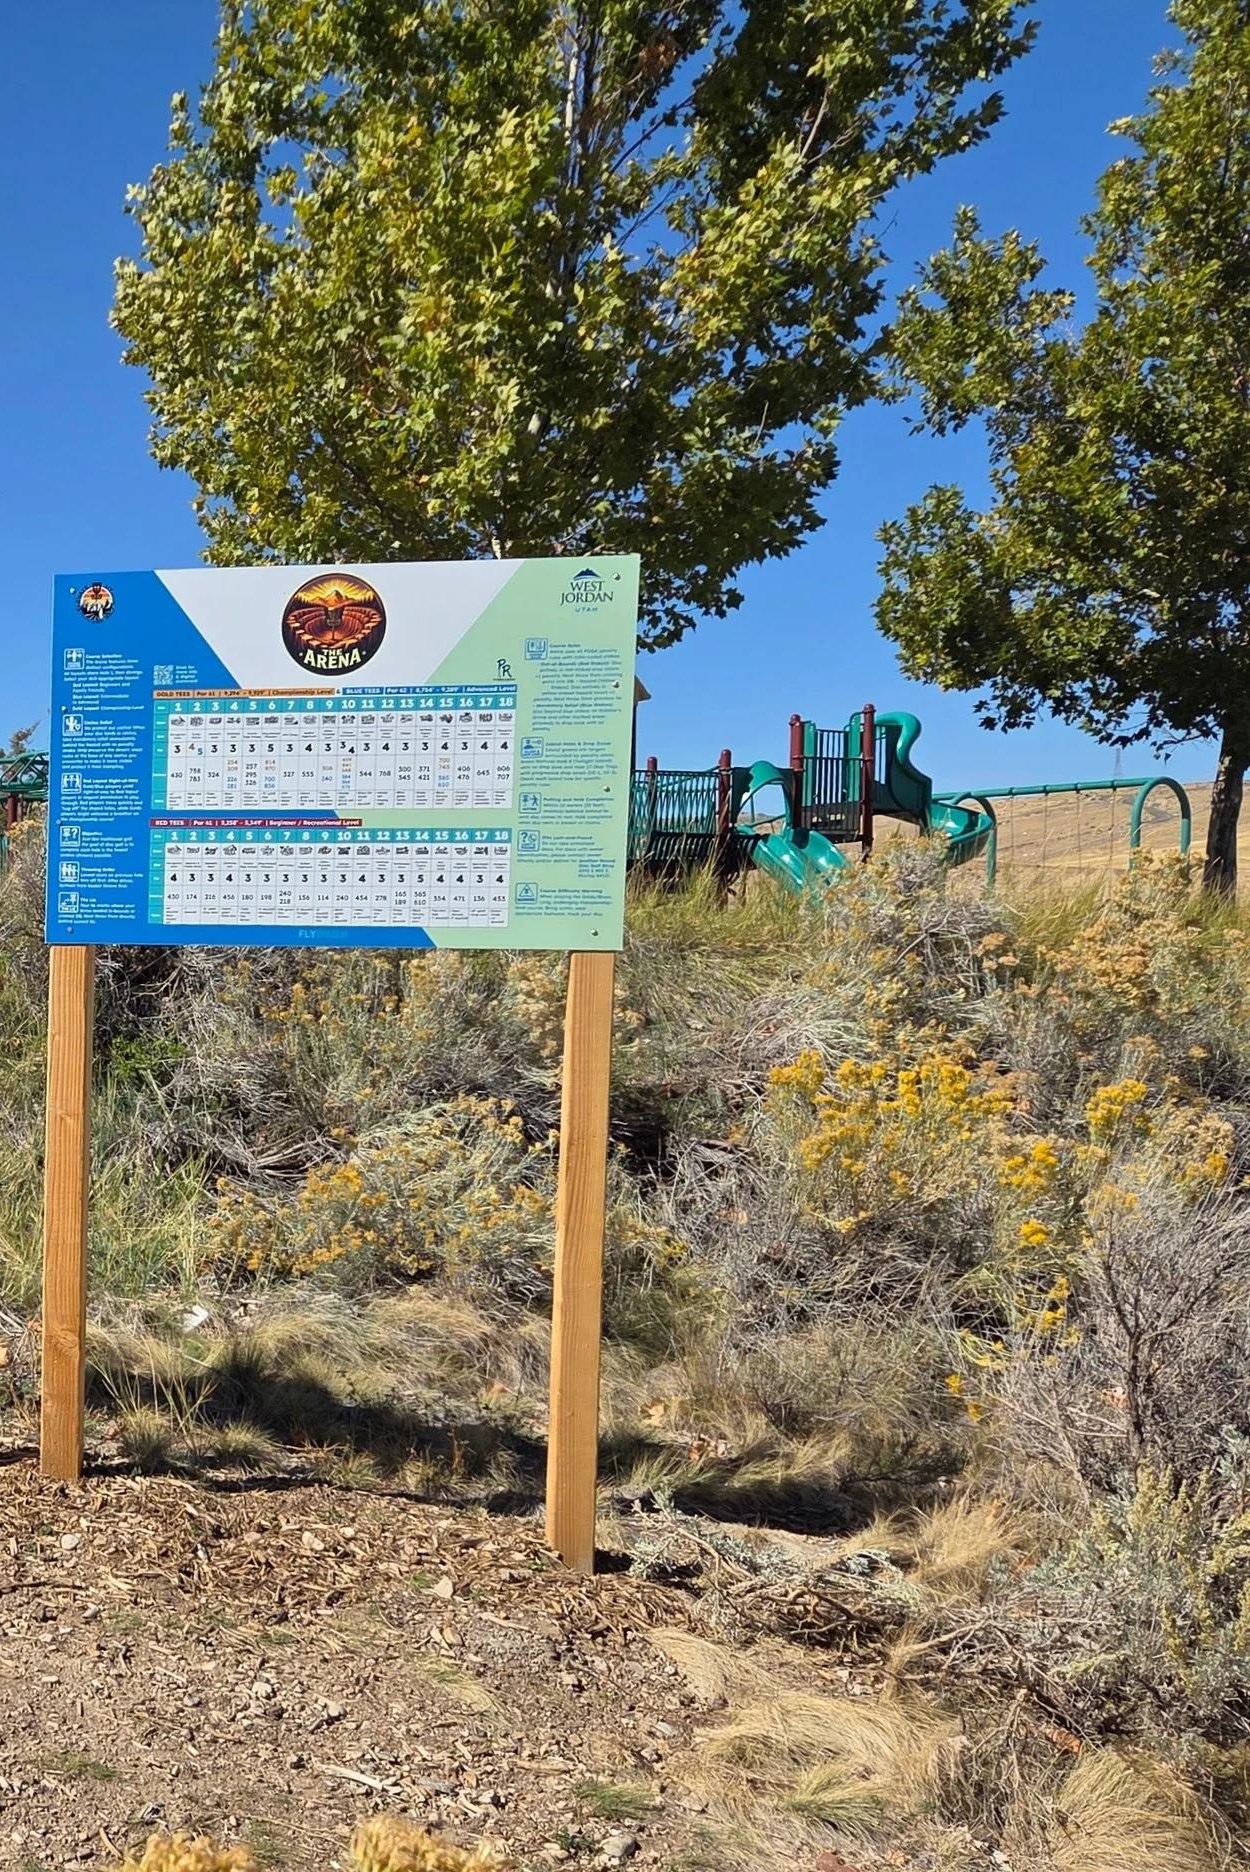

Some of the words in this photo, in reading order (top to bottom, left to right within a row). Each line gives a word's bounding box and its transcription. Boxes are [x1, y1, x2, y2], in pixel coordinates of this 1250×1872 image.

[570, 581, 605, 592] WEST
[561, 592, 613, 605] JORDAN
[321, 648, 343, 656] THE
[303, 648, 361, 669] ARENA
[175, 703, 182, 711] 1
[194, 702, 200, 711] 2
[212, 702, 219, 711] 3
[230, 702, 238, 710] 4
[250, 701, 256, 710] 5
[269, 701, 275, 709] 6
[288, 701, 294, 710] 7
[307, 701, 313, 709] 8
[326, 700, 333, 709] 9
[342, 700, 355, 709] 10
[362, 700, 374, 708] 11
[381, 699, 394, 708] 12
[400, 699, 414, 708] 13
[420, 699, 434, 707] 14
[440, 698, 453, 707] 15
[460, 698, 473, 707] 16
[480, 698, 492, 707] 17
[499, 698, 513, 706] 18
[174, 745, 180, 753] 3
[211, 745, 217, 753] 3
[230, 744, 236, 752] 3
[249, 744, 255, 752] 3
[268, 744, 274, 752] 5
[287, 744, 293, 752] 3
[305, 744, 312, 752] 4
[364, 743, 370, 751] 3
[382, 743, 390, 751] 4
[422, 742, 428, 750] 3
[441, 742, 448, 750] 4
[462, 742, 468, 750] 3
[481, 742, 488, 750] 4
[501, 742, 508, 750] 4
[172, 832, 178, 840] 1
[190, 832, 197, 840] 2
[209, 832, 215, 840] 3
[227, 831, 234, 840] 4
[246, 832, 253, 840] 5
[265, 832, 271, 840] 6
[284, 832, 290, 840] 7
[302, 832, 309, 840] 8
[322, 832, 329, 840] 9
[338, 832, 351, 840] 10
[358, 831, 370, 840] 11
[377, 831, 390, 840] 12
[396, 831, 409, 840] 13
[415, 831, 429, 840] 14
[435, 831, 448, 840] 15
[455, 831, 468, 840] 16
[475, 831, 488, 840] 17
[495, 831, 508, 840] 18
[245, 874, 251, 882] 3
[264, 874, 270, 882] 3
[283, 874, 289, 882] 3
[302, 874, 308, 882] 3
[321, 874, 327, 882] 3
[340, 874, 346, 883] 3
[359, 874, 366, 882] 4
[379, 874, 385, 882] 3
[398, 874, 404, 882] 3
[418, 875, 423, 883] 5
[457, 875, 464, 883] 4
[477, 875, 483, 883] 3
[496, 875, 503, 883] 4
[299, 930, 316, 938] FLY
